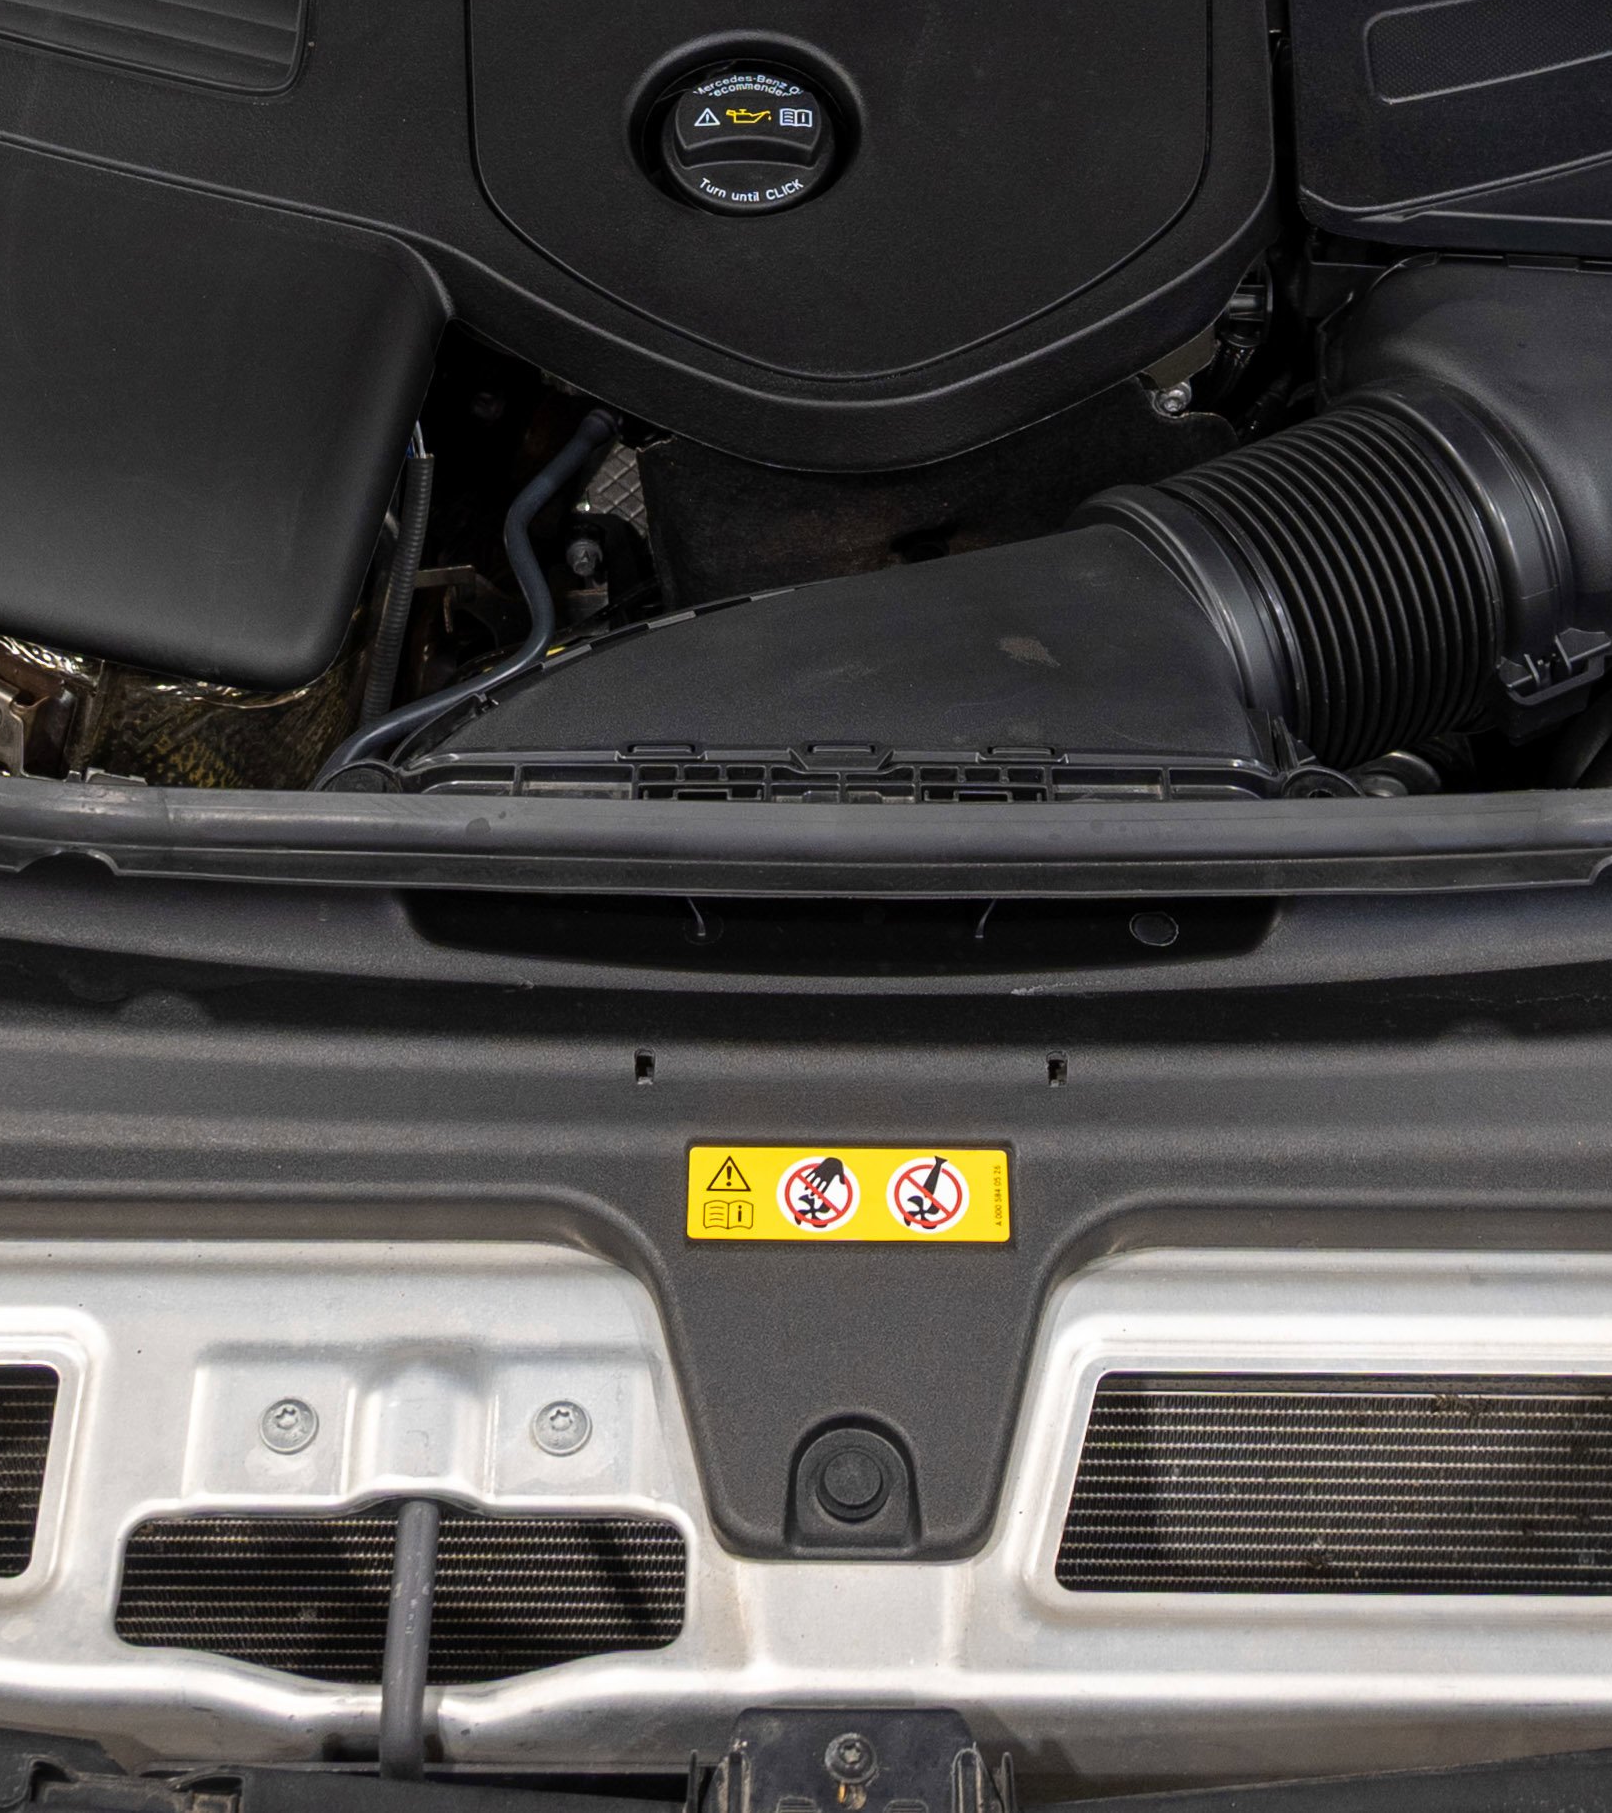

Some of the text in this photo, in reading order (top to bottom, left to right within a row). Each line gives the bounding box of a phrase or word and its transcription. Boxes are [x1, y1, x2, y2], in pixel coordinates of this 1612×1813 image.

[699, 177, 804, 202] Turn until CLICK
